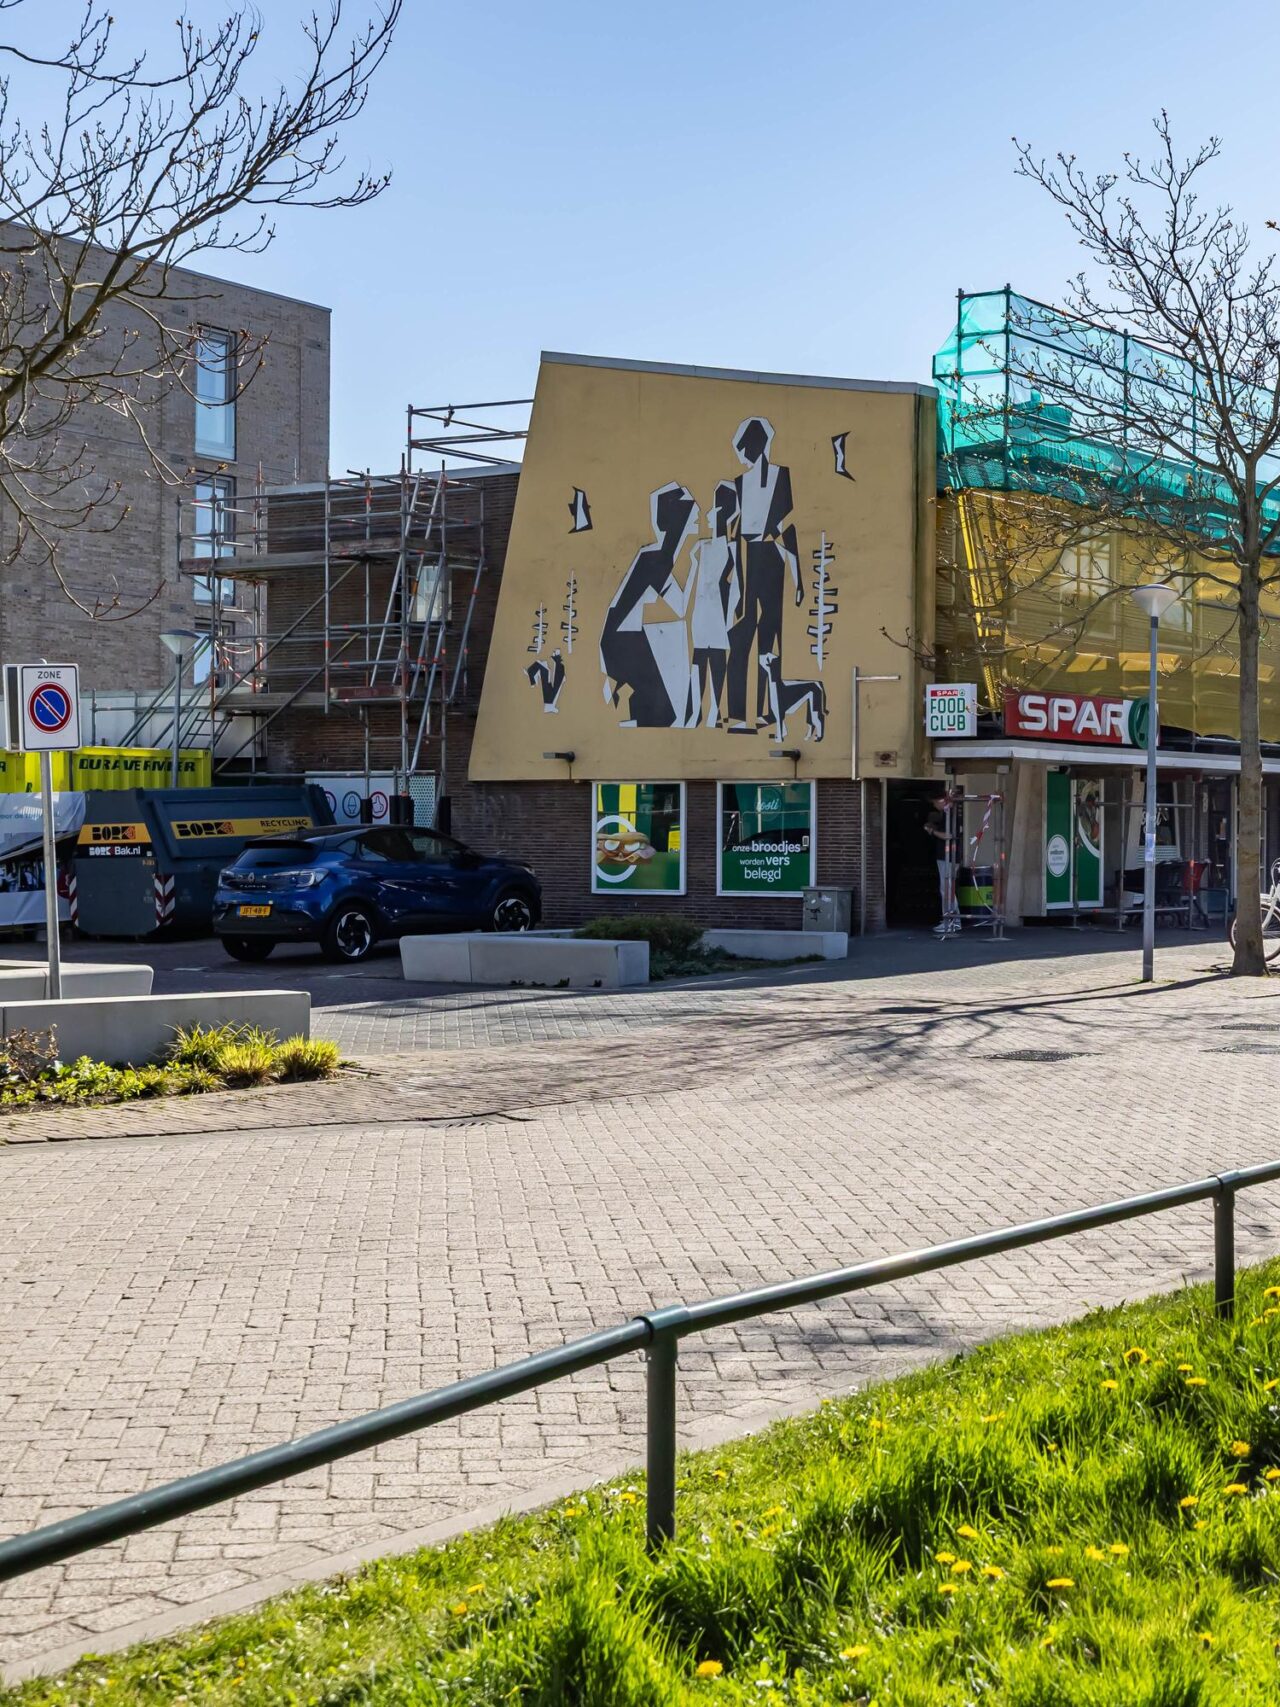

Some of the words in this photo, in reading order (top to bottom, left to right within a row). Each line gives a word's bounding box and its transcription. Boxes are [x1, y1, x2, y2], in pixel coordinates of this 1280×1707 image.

[37, 671, 61, 679] ZONE
[931, 698, 965, 713] FOOD
[1018, 694, 1124, 737] SPAR
[931, 715, 965, 731] CLUB
[260, 819, 308, 827] RECYCLING
[751, 841, 801, 855] broodjes
[765, 857, 790, 866] vers
[744, 867, 782, 883] belegd
